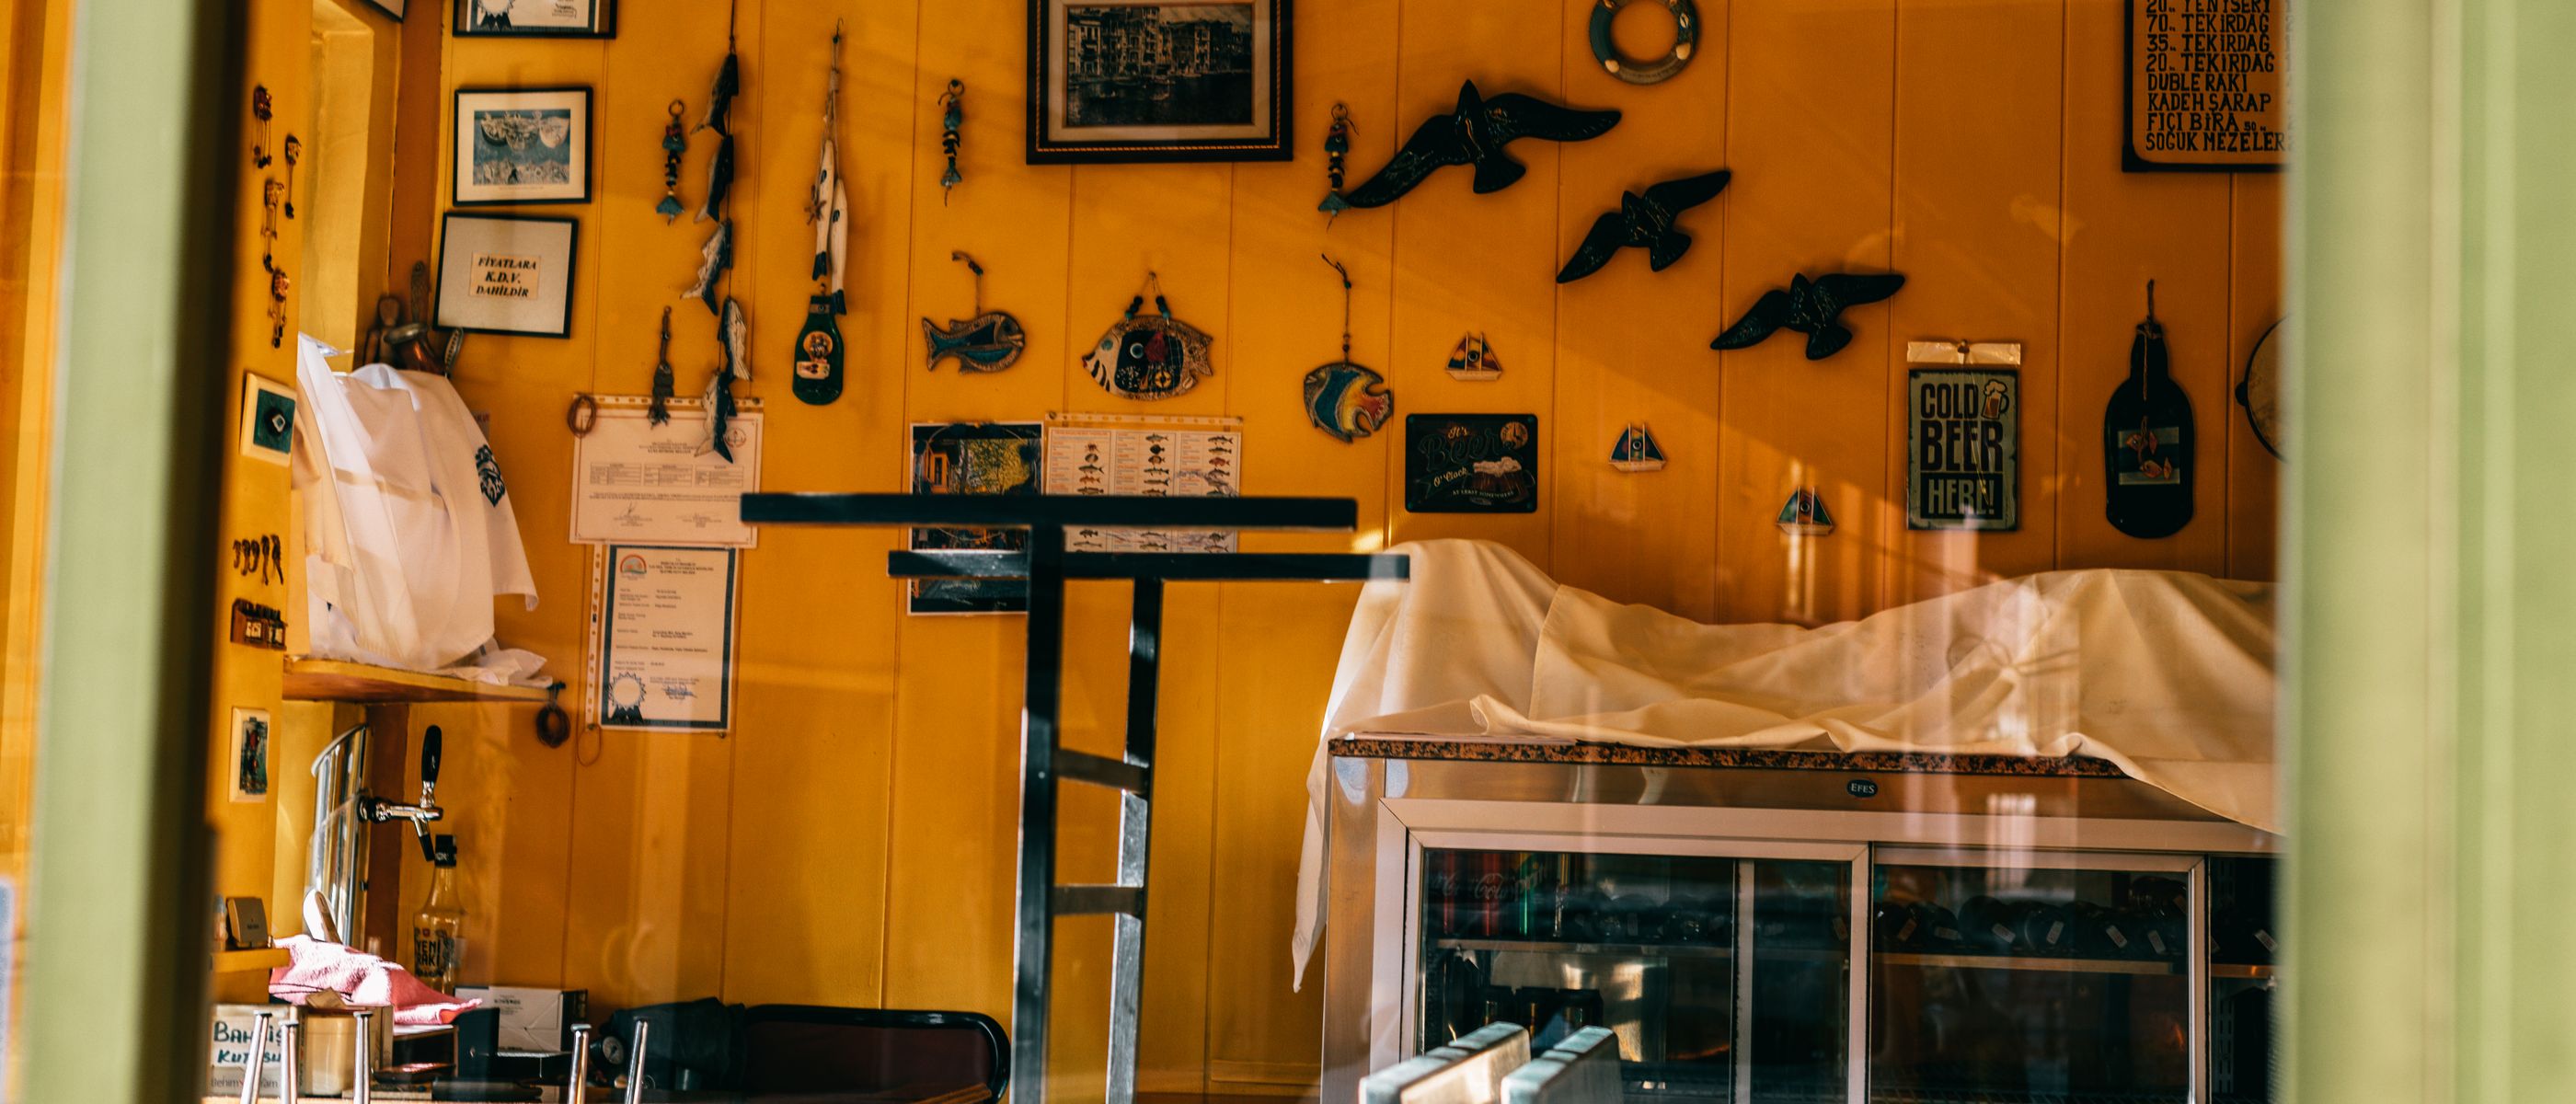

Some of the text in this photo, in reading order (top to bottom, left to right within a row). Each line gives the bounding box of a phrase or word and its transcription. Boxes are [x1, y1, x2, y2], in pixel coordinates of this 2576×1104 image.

[2146, 14, 2168, 32] 70
[2146, 34, 2169, 52] 35
[2145, 53, 2168, 73] 20
[2147, 73, 2248, 92] DUBLE RAKI
[2147, 93, 2204, 111] KADEH
[486, 271, 521, 284] K.D.V.
[1920, 383, 1979, 419] COLD
[1920, 420, 2004, 472] BEER
[1928, 478, 1995, 515] HERE!
[1851, 783, 1875, 794] EFES
